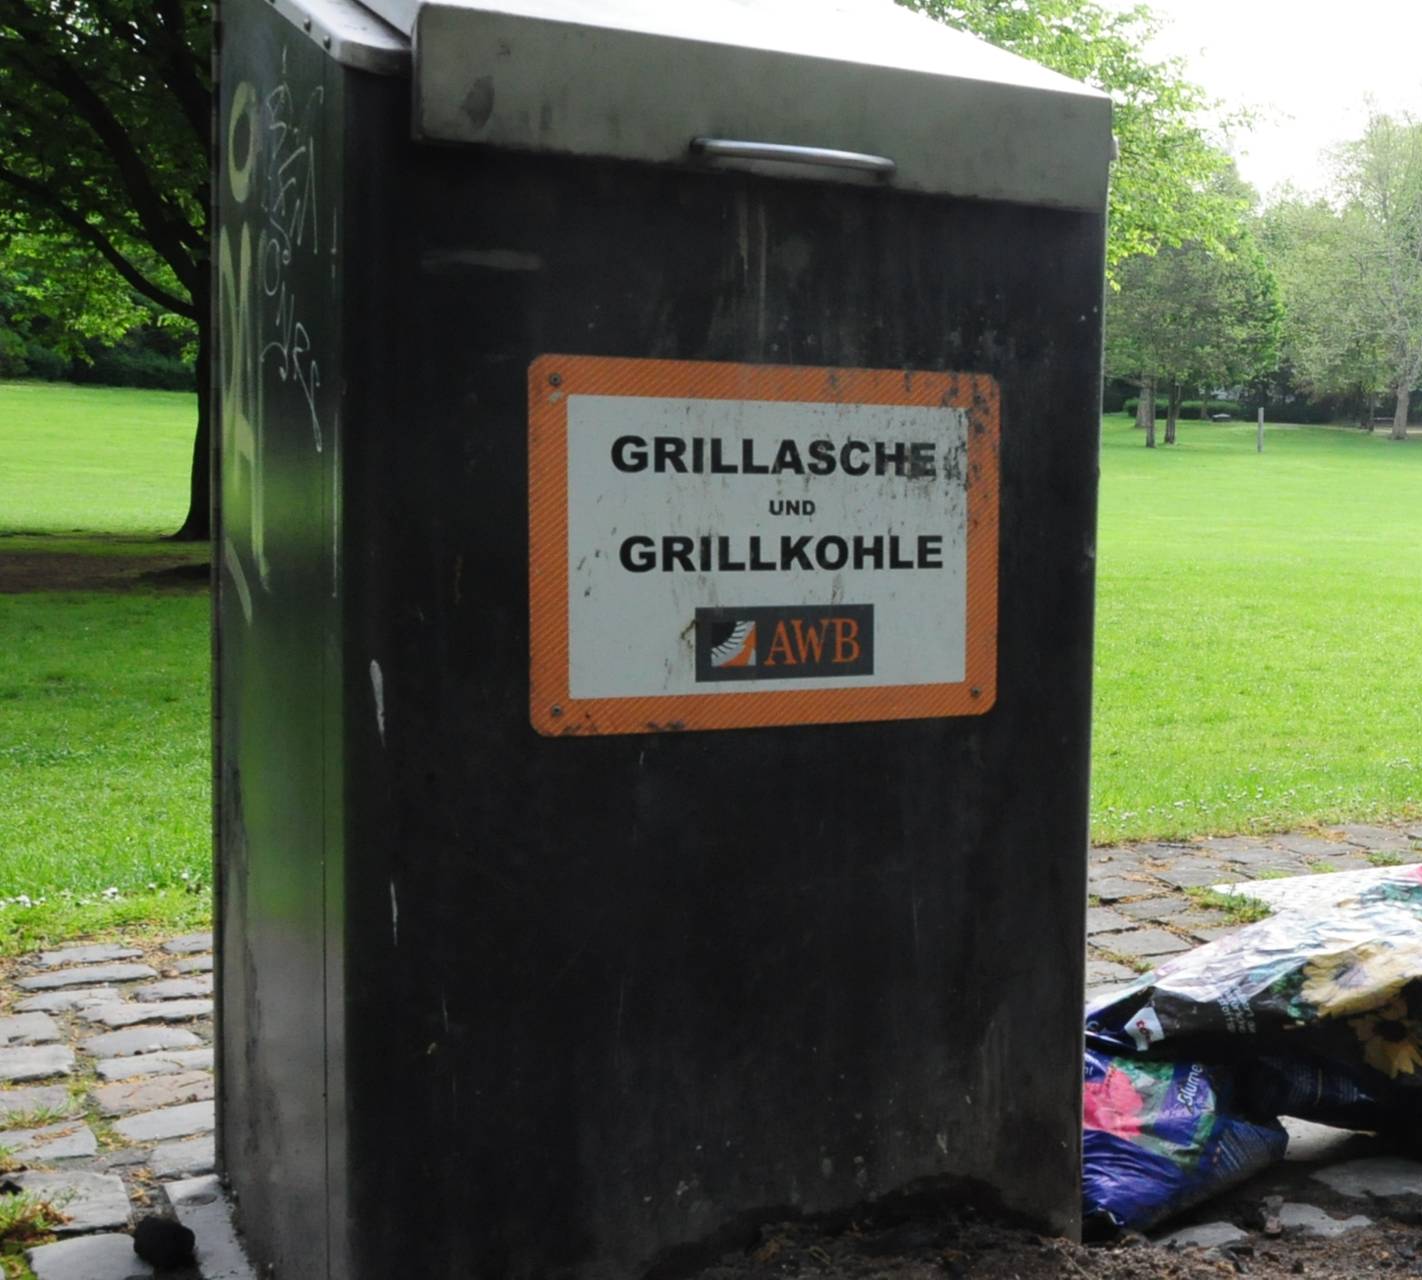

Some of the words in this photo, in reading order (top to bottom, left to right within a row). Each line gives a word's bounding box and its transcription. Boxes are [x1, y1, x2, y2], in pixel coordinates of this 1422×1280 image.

[610, 435, 937, 477] GRILLASCHE
[769, 500, 816, 516] UND
[619, 535, 944, 573] GRILLKOHLE
[763, 617, 861, 667] AWB
